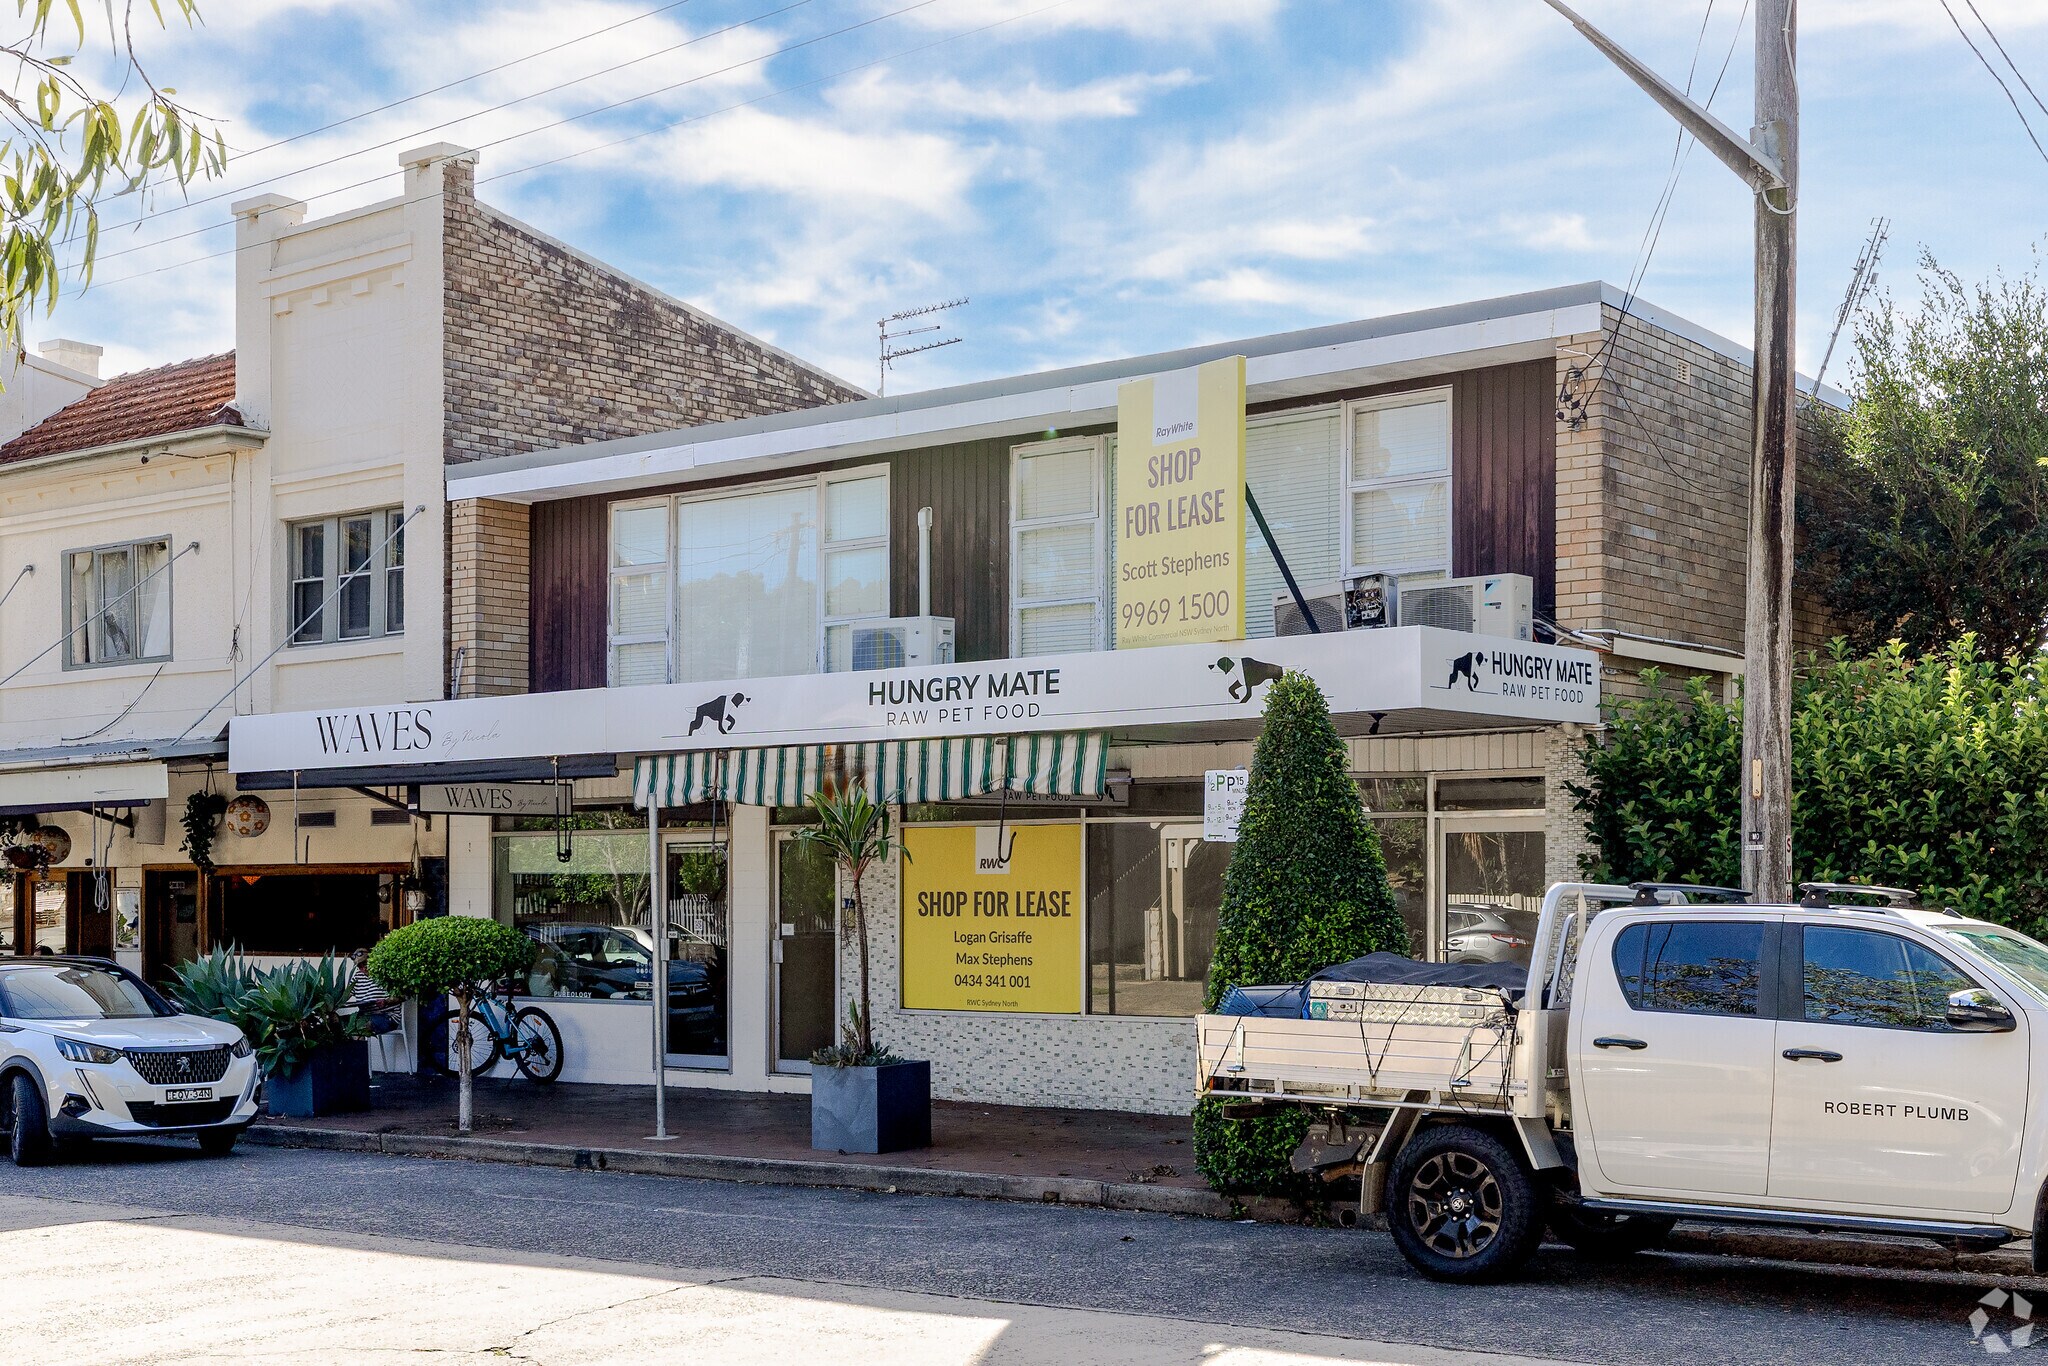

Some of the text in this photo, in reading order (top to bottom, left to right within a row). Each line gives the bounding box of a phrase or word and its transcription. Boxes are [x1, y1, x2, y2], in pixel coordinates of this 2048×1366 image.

[1147, 447, 1201, 489] SHOP
[1126, 489, 1225, 538] FOR LEASE
[1122, 551, 1230, 582] Scott Stephens
[1122, 590, 1230, 629] 9969 1500
[1492, 651, 1592, 685] HUNGRY MATE
[868, 669, 1060, 706] HUNGRY MATE
[1502, 682, 1584, 704] RAW PET FOOD
[887, 703, 1041, 727] RAW PET FOOD
[316, 709, 433, 755] WAVES
[444, 787, 513, 810] WAVES
[980, 858, 1004, 869] RWC
[917, 890, 1071, 917] SHOP FOR LEASE
[954, 931, 1032, 946] Logan Grisaffe
[956, 952, 1033, 967] Max Stephens
[954, 974, 1031, 988] 0434 341 001
[966, 999, 981, 1007] RWC
[981, 999, 1001, 1008] Sydney
[1824, 1101, 1969, 1121] ROBERT PLUMB
